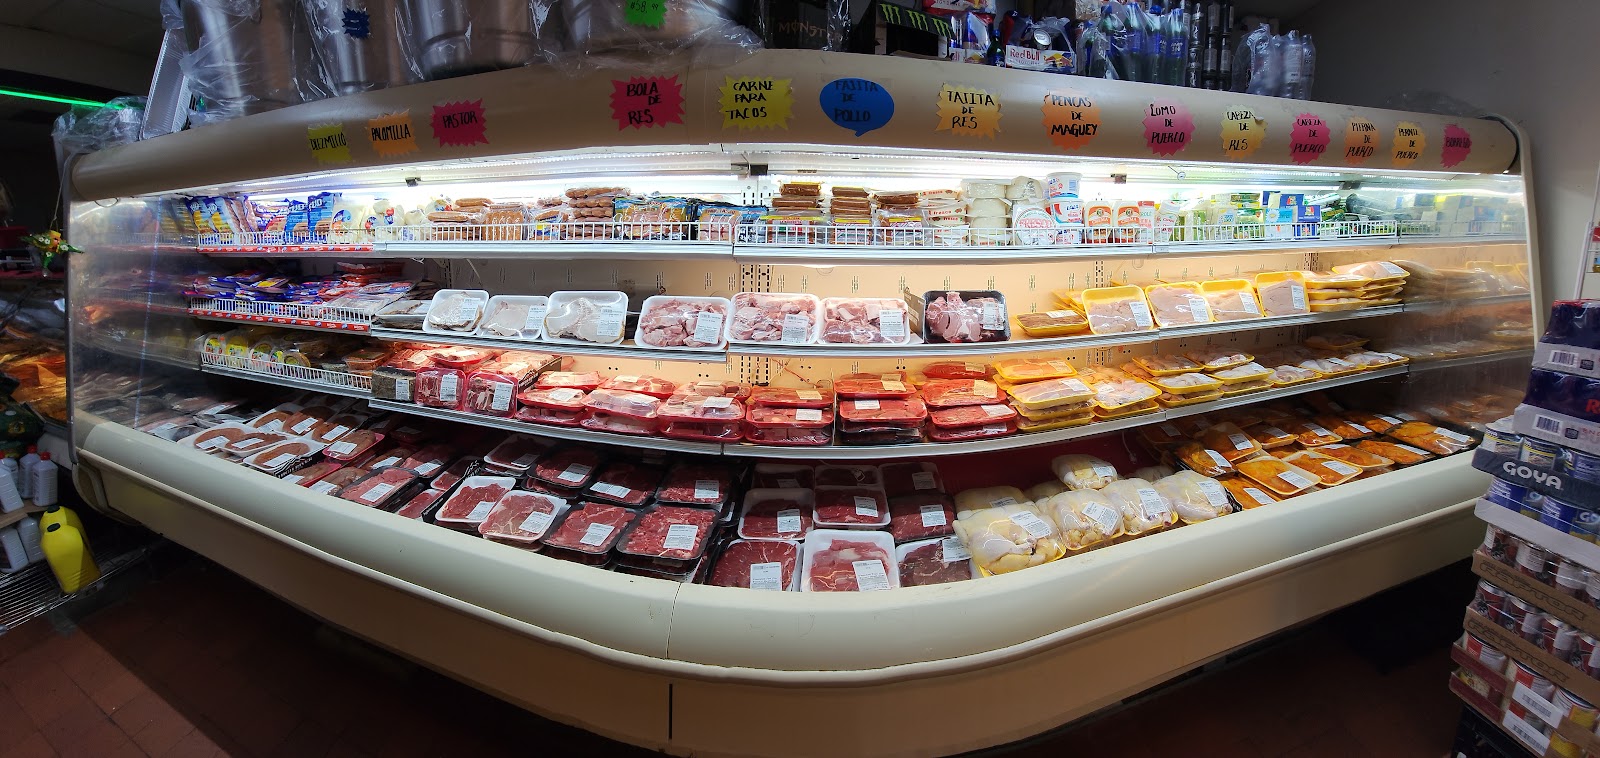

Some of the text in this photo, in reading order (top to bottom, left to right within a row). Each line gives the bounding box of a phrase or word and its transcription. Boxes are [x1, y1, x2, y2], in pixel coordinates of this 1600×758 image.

[1010, 48, 1040, 61] Red Bull
[626, 82, 659, 97] BOLA
[733, 80, 774, 92] CARNE
[648, 95, 661, 106] DE
[734, 93, 767, 103] PARA
[841, 92, 857, 103] DE
[1051, 94, 1092, 108] PENCAS
[627, 108, 654, 125] RES
[726, 106, 768, 120] TACOS
[834, 109, 871, 122] POLLO
[961, 106, 975, 115] DE
[1071, 111, 1084, 121] DE
[442, 111, 478, 129] PASTOR
[951, 116, 978, 129] RES
[1164, 118, 1174, 128] DE
[1051, 123, 1098, 138] MAGUEY
[1238, 122, 1249, 131] DE
[1351, 122, 1376, 132] PIERNA
[1398, 128, 1419, 137] PERNIL
[371, 124, 411, 142] PALOMILLA
[1151, 131, 1185, 144] PUERCO
[1308, 129, 1318, 138] DE
[1363, 134, 1371, 144] DE
[309, 132, 347, 151] DIEZMILLO
[1228, 139, 1248, 151] RES
[1409, 139, 1416, 148] DE
[1293, 143, 1325, 153] PUERCO
[1345, 146, 1374, 158] PUERCO
[1395, 151, 1419, 160] PUERCO
[1502, 461, 1563, 490] GOYA
